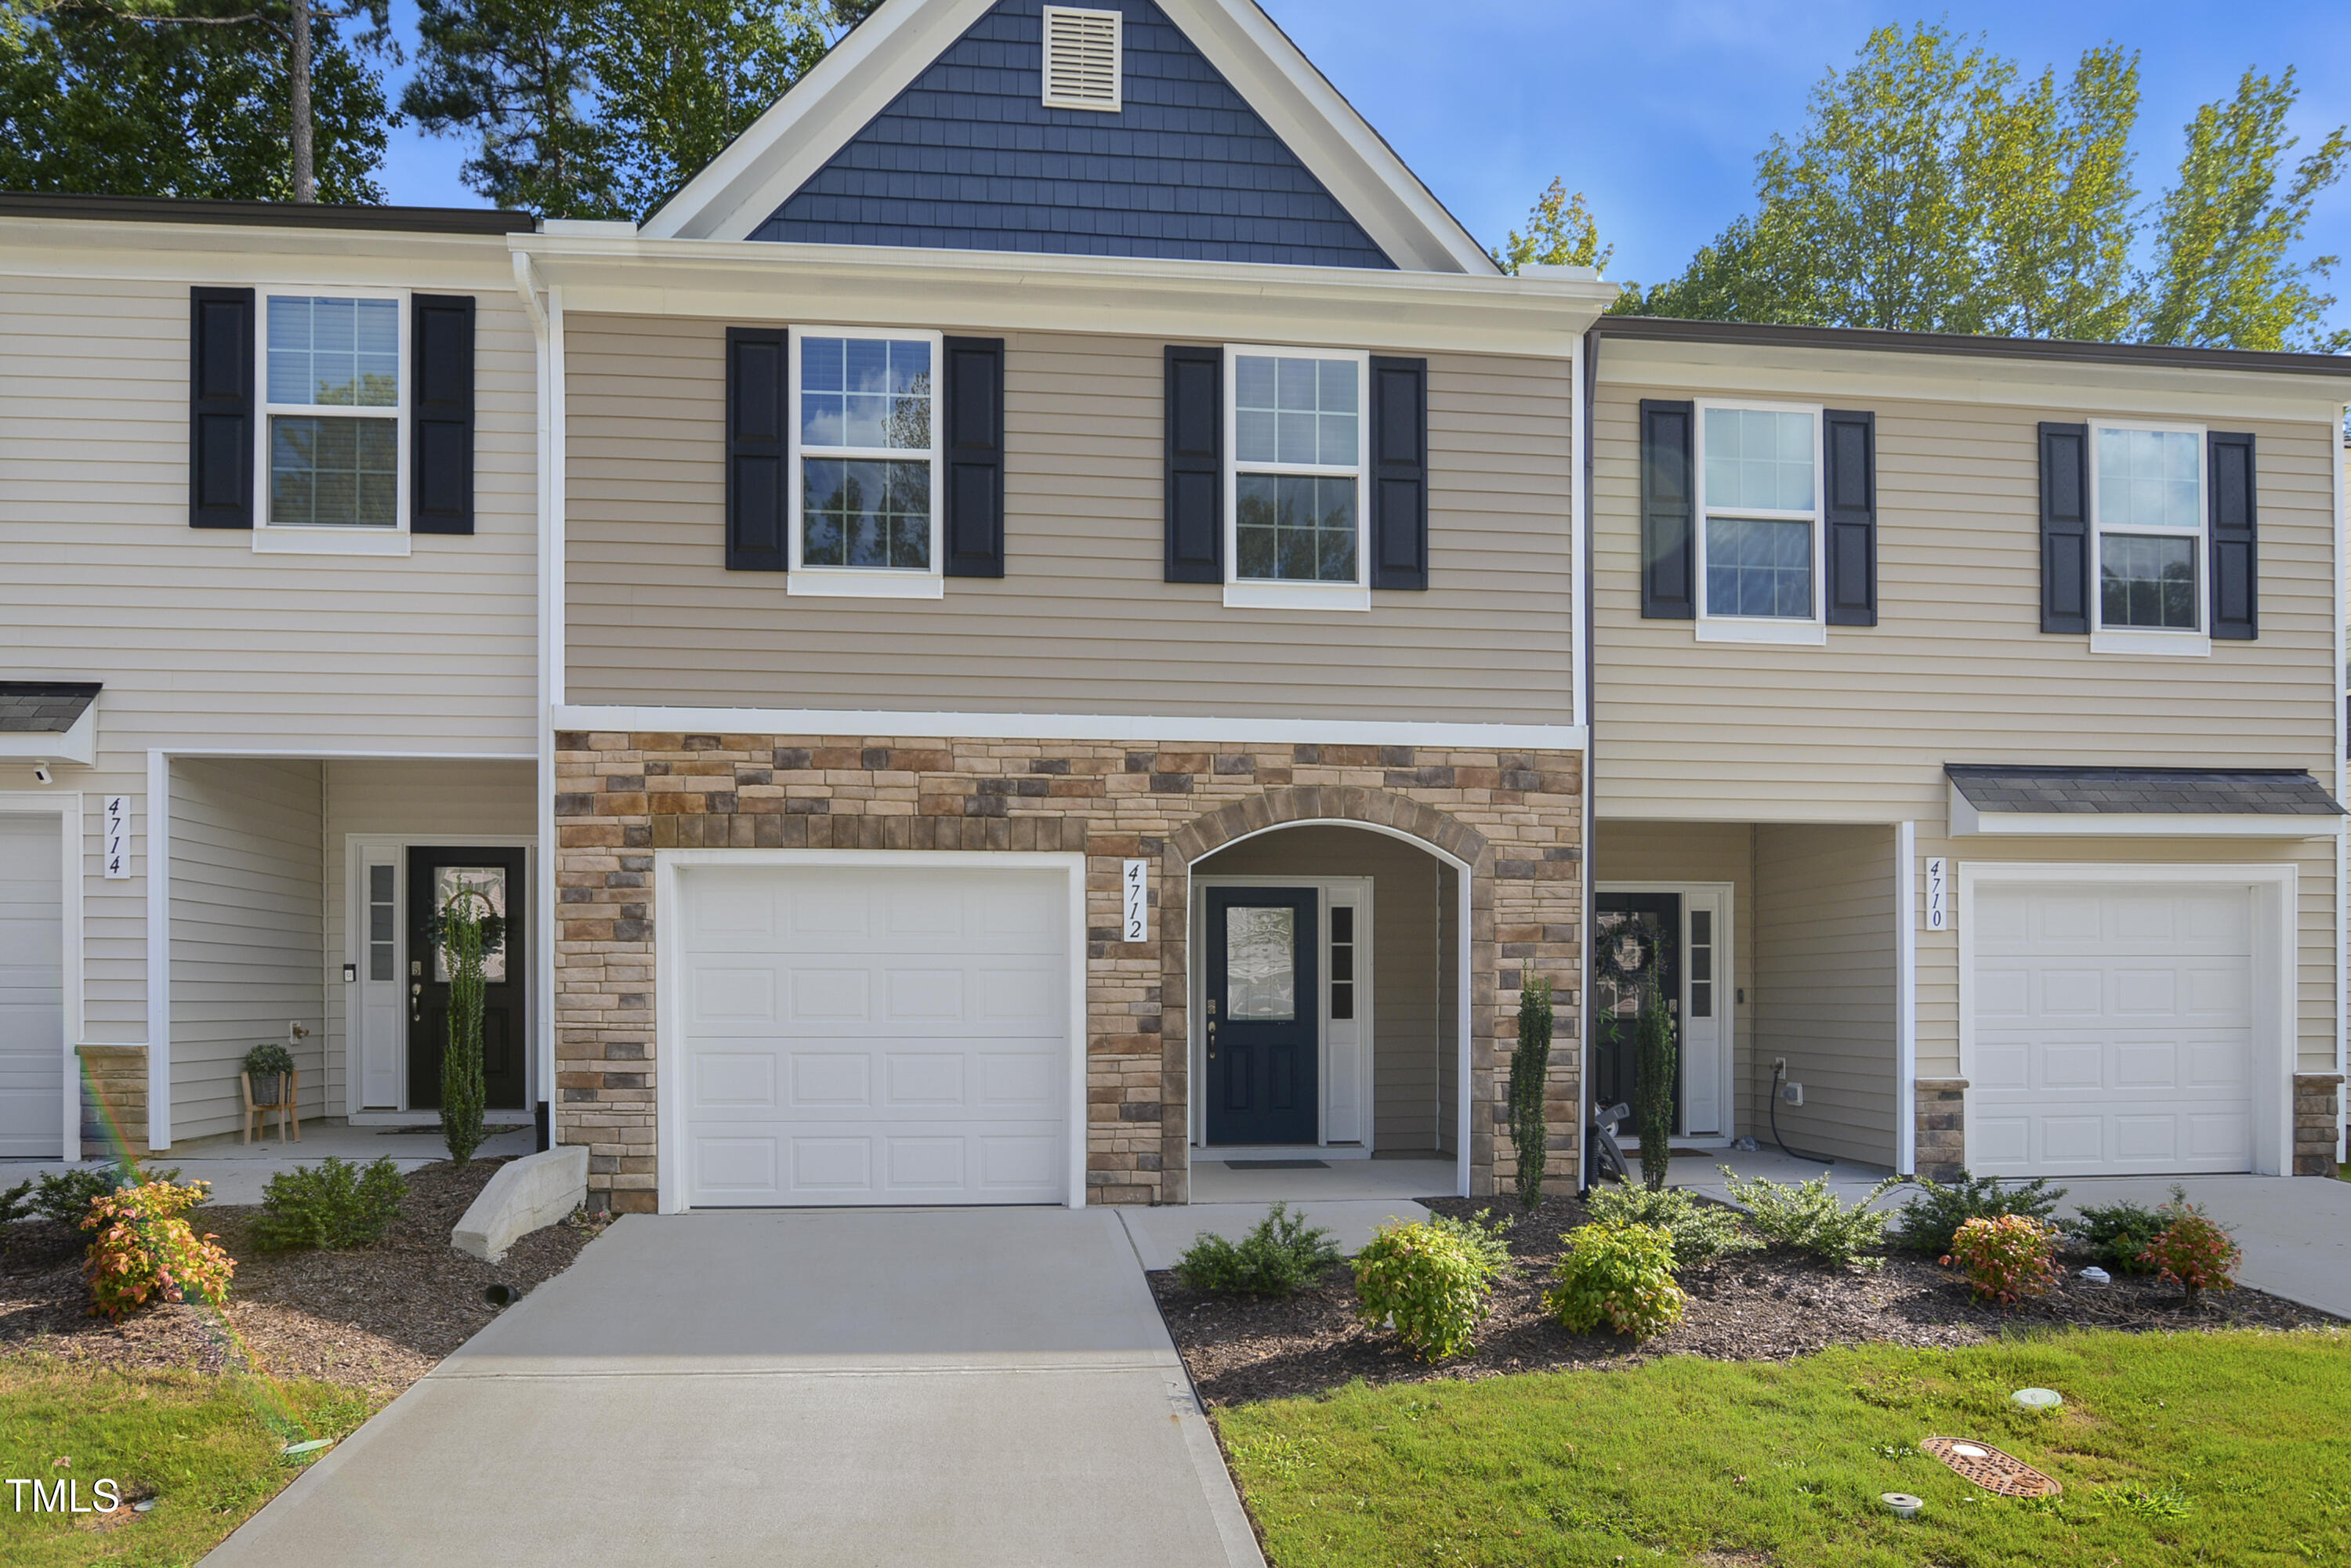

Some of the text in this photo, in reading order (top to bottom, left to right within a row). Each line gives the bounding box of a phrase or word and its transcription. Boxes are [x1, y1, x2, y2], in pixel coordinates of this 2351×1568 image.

[108, 797, 121, 874] 4714
[1128, 864, 1141, 938] 4712
[1930, 860, 1941, 926] 4710
